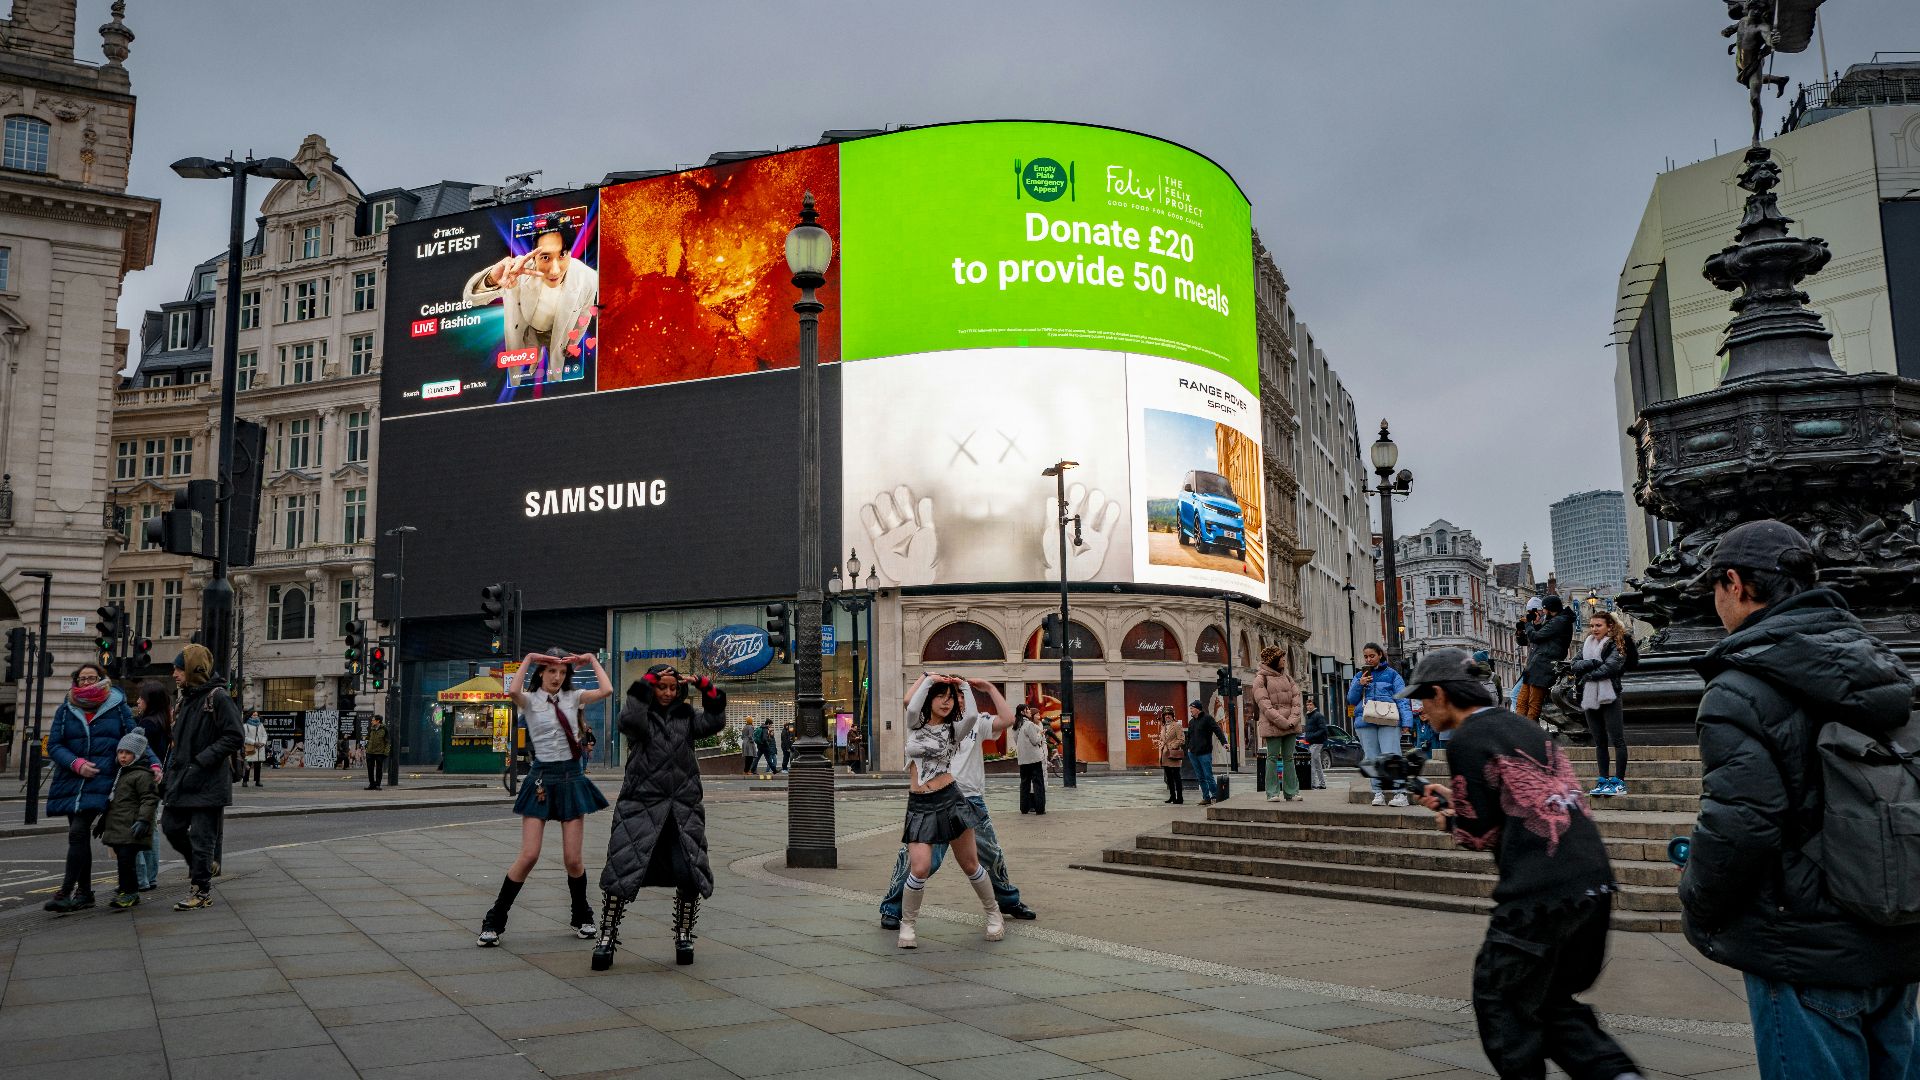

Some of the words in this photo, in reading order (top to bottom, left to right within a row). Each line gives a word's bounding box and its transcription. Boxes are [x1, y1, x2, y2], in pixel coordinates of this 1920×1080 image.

[1033, 165, 1056, 173] Empty
[1026, 179, 1064, 187] Emergency
[1106, 165, 1155, 201] Felix
[1165, 176, 1183, 189] THE
[1165, 187, 1191, 202] FELIX
[1107, 200, 1128, 208] GOOD
[1131, 203, 1150, 212] FOOD
[1167, 211, 1184, 221] GOOD
[1165, 198, 1203, 217] PROJECT
[441, 227, 465, 238] TikTok
[1026, 212, 1140, 250] Donate
[1149, 225, 1194, 263] £20
[417, 239, 446, 259] LIVE
[448, 235, 481, 254] FEST
[952, 257, 988, 285] to
[999, 254, 1125, 291] provide
[1134, 262, 1167, 294] 50
[1174, 275, 1230, 317] meals
[420, 299, 473, 317] Celebrate
[414, 322, 435, 335] LIVE
[440, 315, 481, 330] fashion
[500, 352, 535, 365] @rico9_c
[1179, 378, 1222, 399] RANGE
[1224, 391, 1248, 411] ROVER
[1207, 399, 1237, 417] SPORT
[525, 479, 666, 518] SAMSUNG
[707, 632, 764, 666] Boots
[945, 639, 975, 651] Lindt
[1135, 639, 1158, 649] Lindt
[624, 646, 687, 662] pharmacy
[473, 738, 493, 746] DOG
